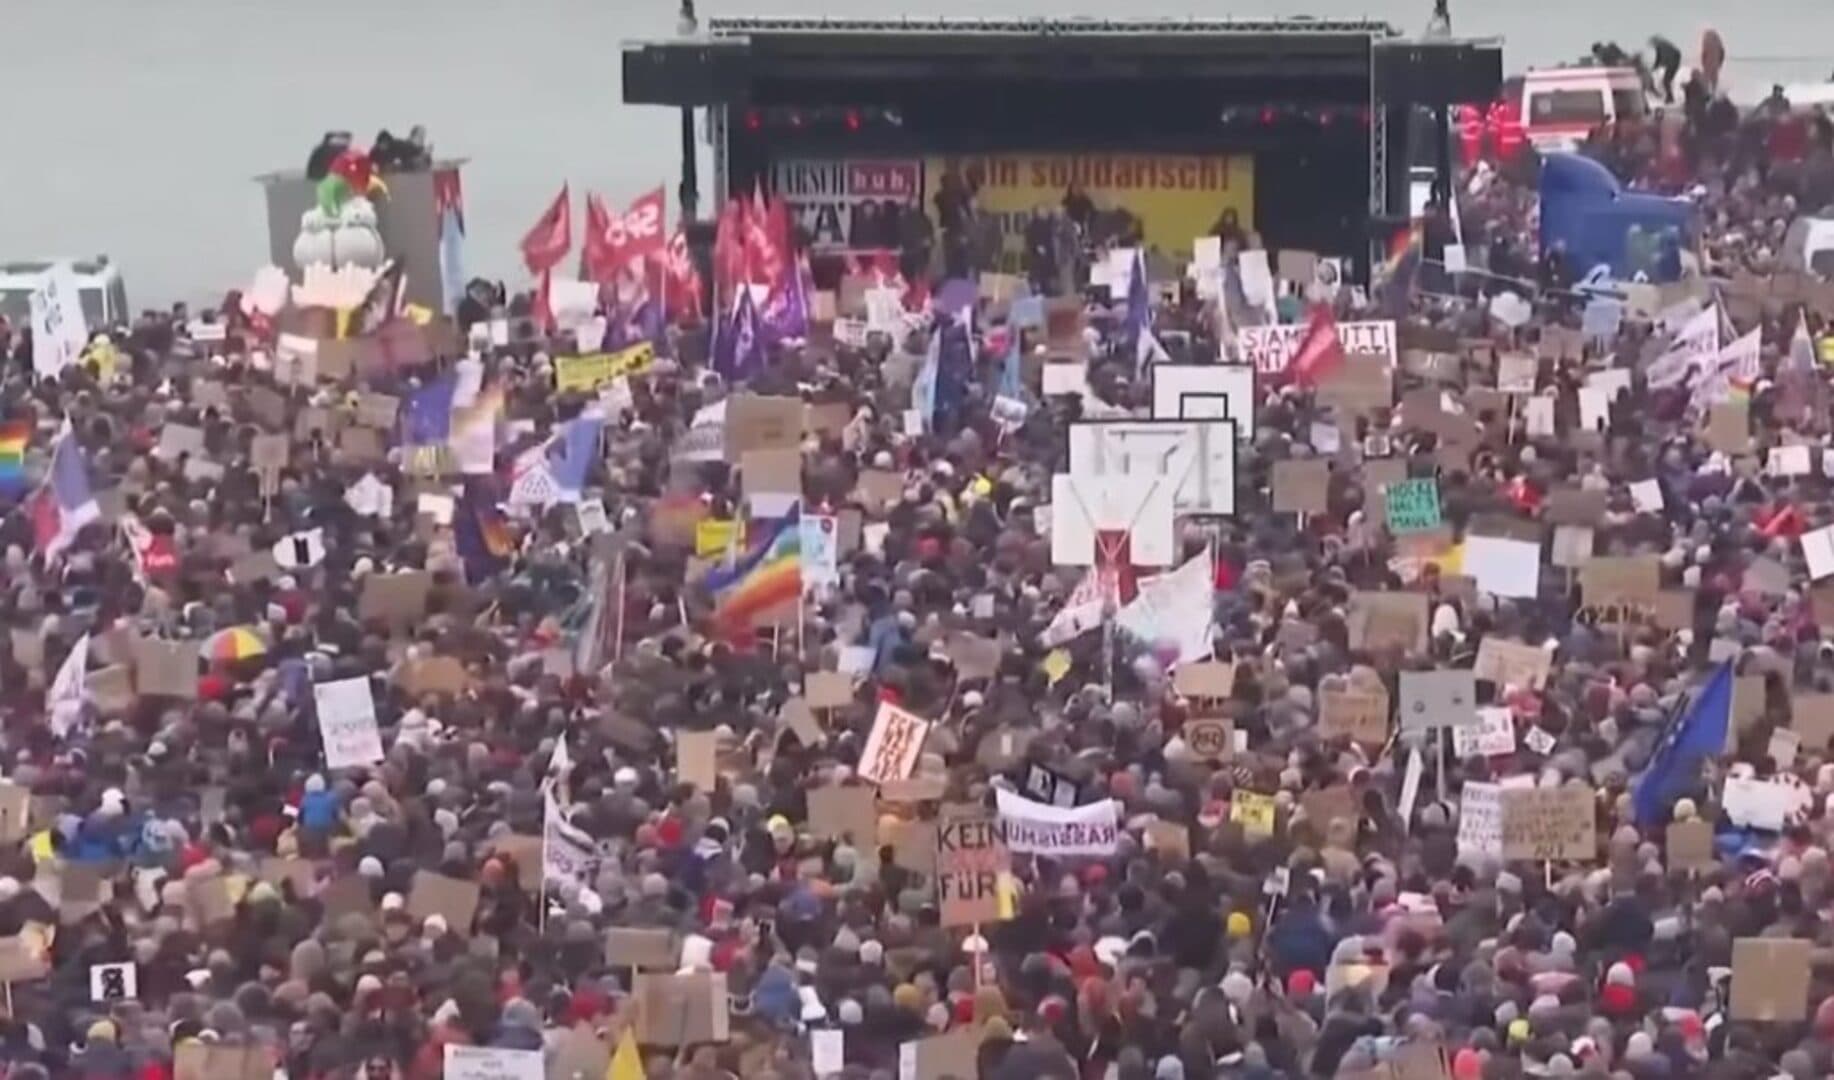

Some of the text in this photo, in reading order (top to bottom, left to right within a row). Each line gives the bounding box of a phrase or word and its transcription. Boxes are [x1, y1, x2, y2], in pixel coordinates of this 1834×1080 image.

[1244, 326, 1308, 349] SIAM
[937, 820, 1008, 854] KEIN
[940, 869, 997, 903] FÜR
